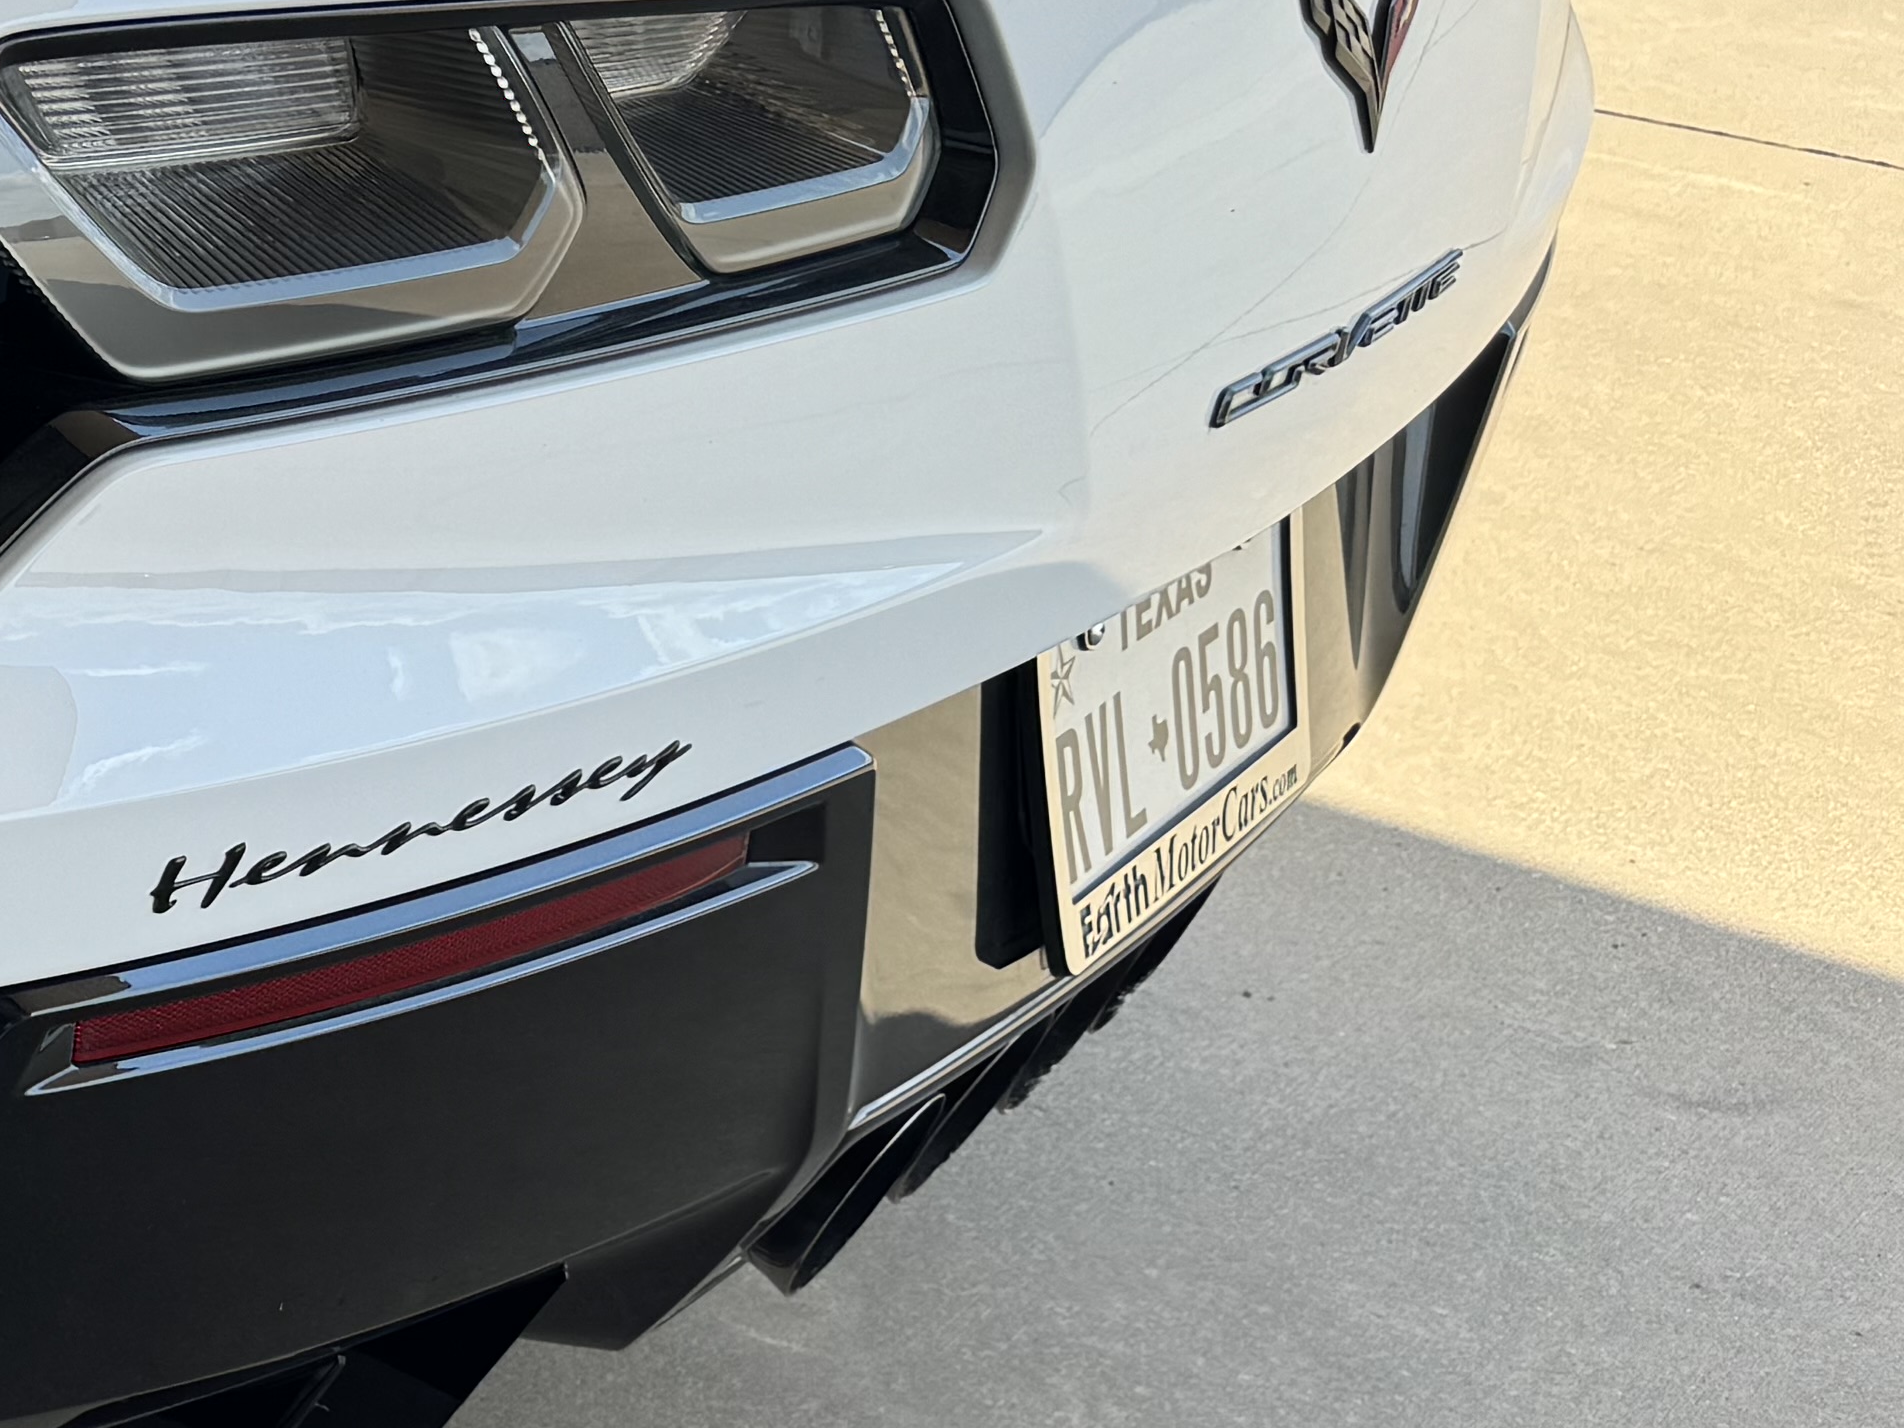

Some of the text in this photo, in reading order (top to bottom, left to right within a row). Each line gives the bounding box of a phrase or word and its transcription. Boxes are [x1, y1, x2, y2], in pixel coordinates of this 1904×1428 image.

[149, 739, 693, 914] Hennessey
[1055, 589, 1280, 885] RVL 0586
